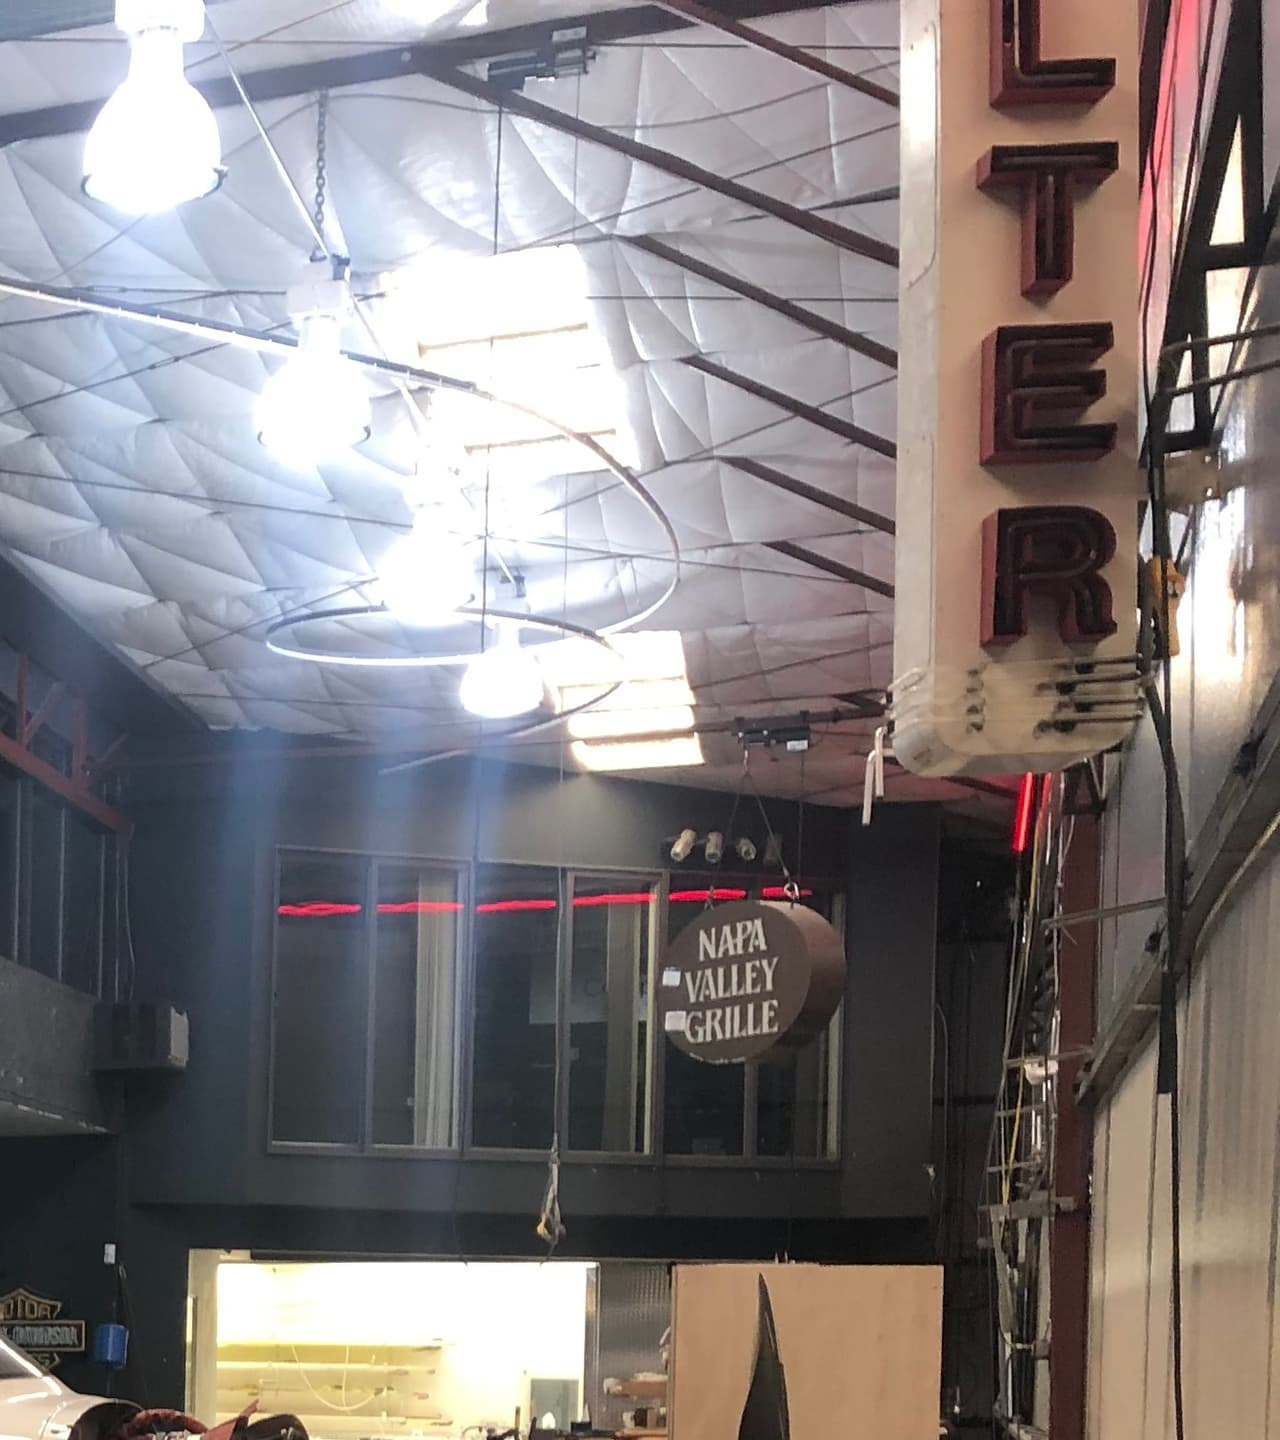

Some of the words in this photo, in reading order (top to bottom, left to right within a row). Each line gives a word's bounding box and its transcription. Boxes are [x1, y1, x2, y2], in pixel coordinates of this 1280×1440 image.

[698, 917, 768, 962] NAPA
[684, 956, 779, 1004] VALLEY
[685, 999, 779, 1044] GRILLE
